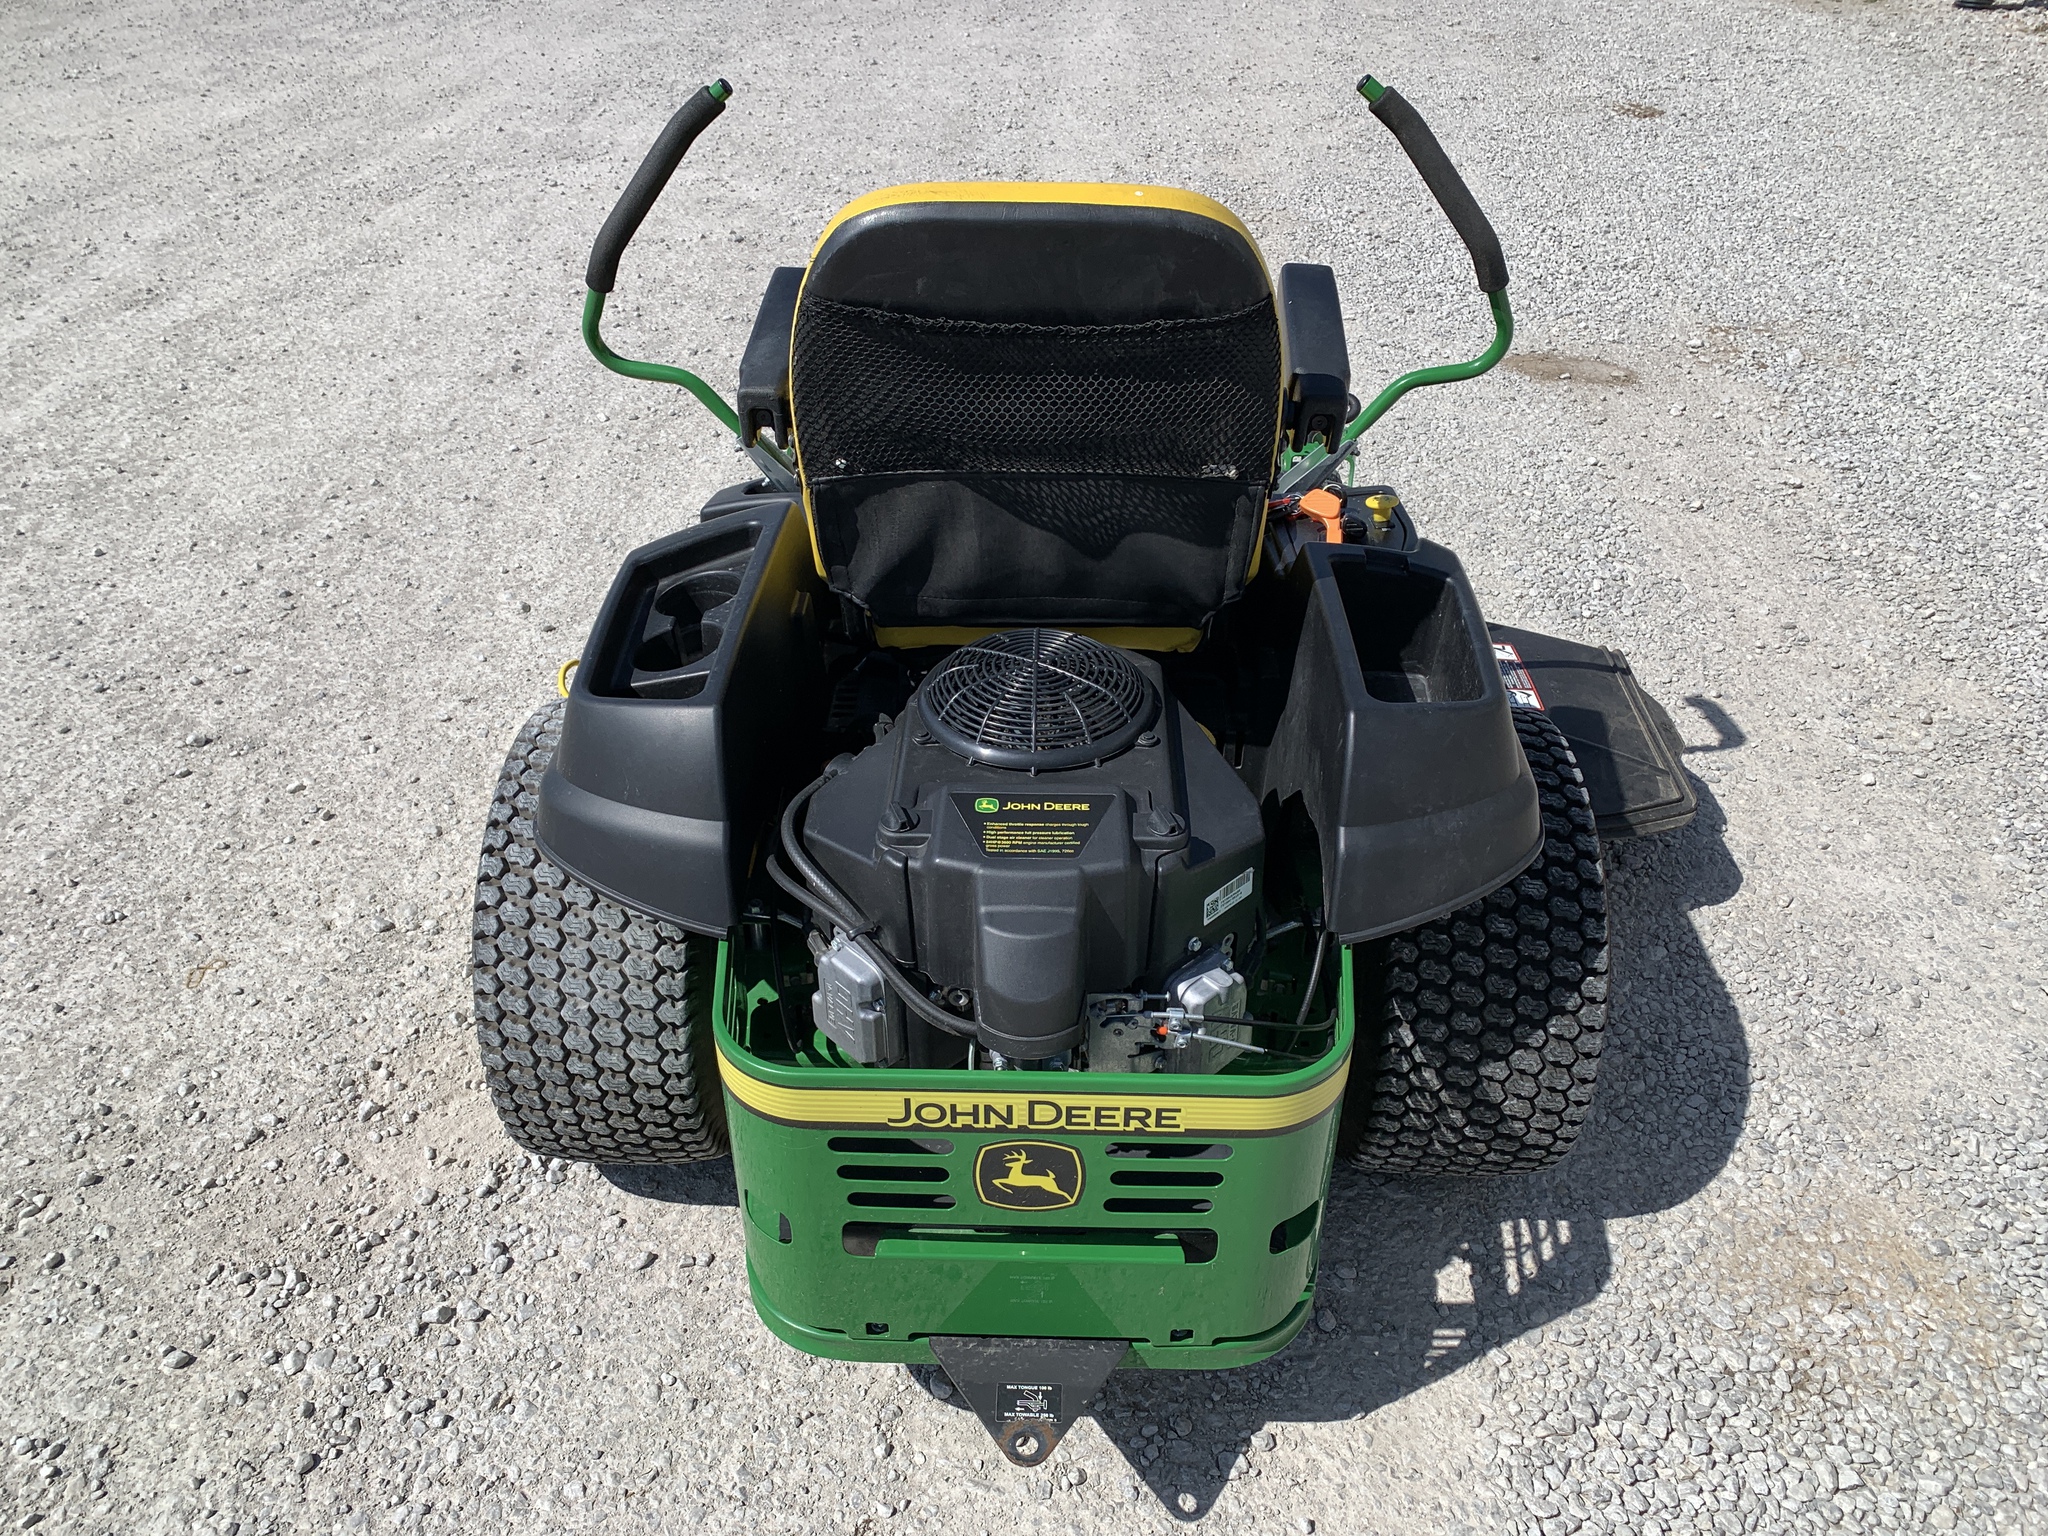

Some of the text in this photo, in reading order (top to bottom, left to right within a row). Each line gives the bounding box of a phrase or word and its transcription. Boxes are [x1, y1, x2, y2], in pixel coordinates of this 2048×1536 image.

[1002, 801, 1091, 811] JOHN DEERE
[887, 1097, 1183, 1129] JOHN DEERE
